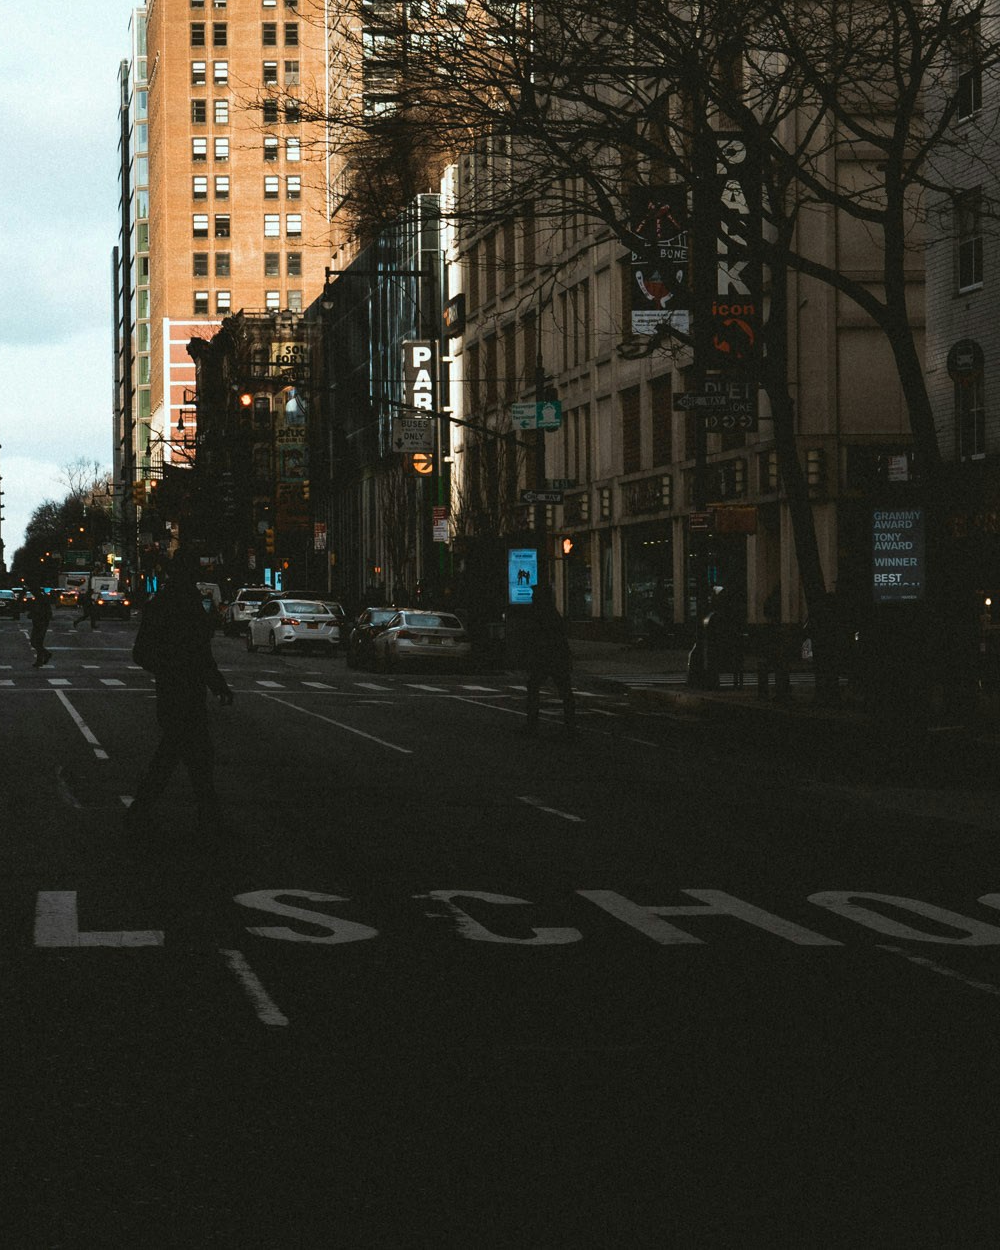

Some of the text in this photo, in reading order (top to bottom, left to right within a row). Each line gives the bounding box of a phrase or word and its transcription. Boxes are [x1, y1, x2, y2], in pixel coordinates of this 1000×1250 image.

[711, 300, 755, 316] icon
[413, 347, 433, 418] PAR
[401, 420, 428, 428] BUSES
[403, 432, 424, 440] ONLY
[873, 511, 921, 520] GRAMMY
[873, 520, 913, 529] AWARD
[874, 533, 902, 542] TONY
[874, 541, 913, 551] AWARD
[874, 557, 918, 567] WINNER
[873, 573, 902, 583] BEST
[232, 888, 1000, 948] SCHO
